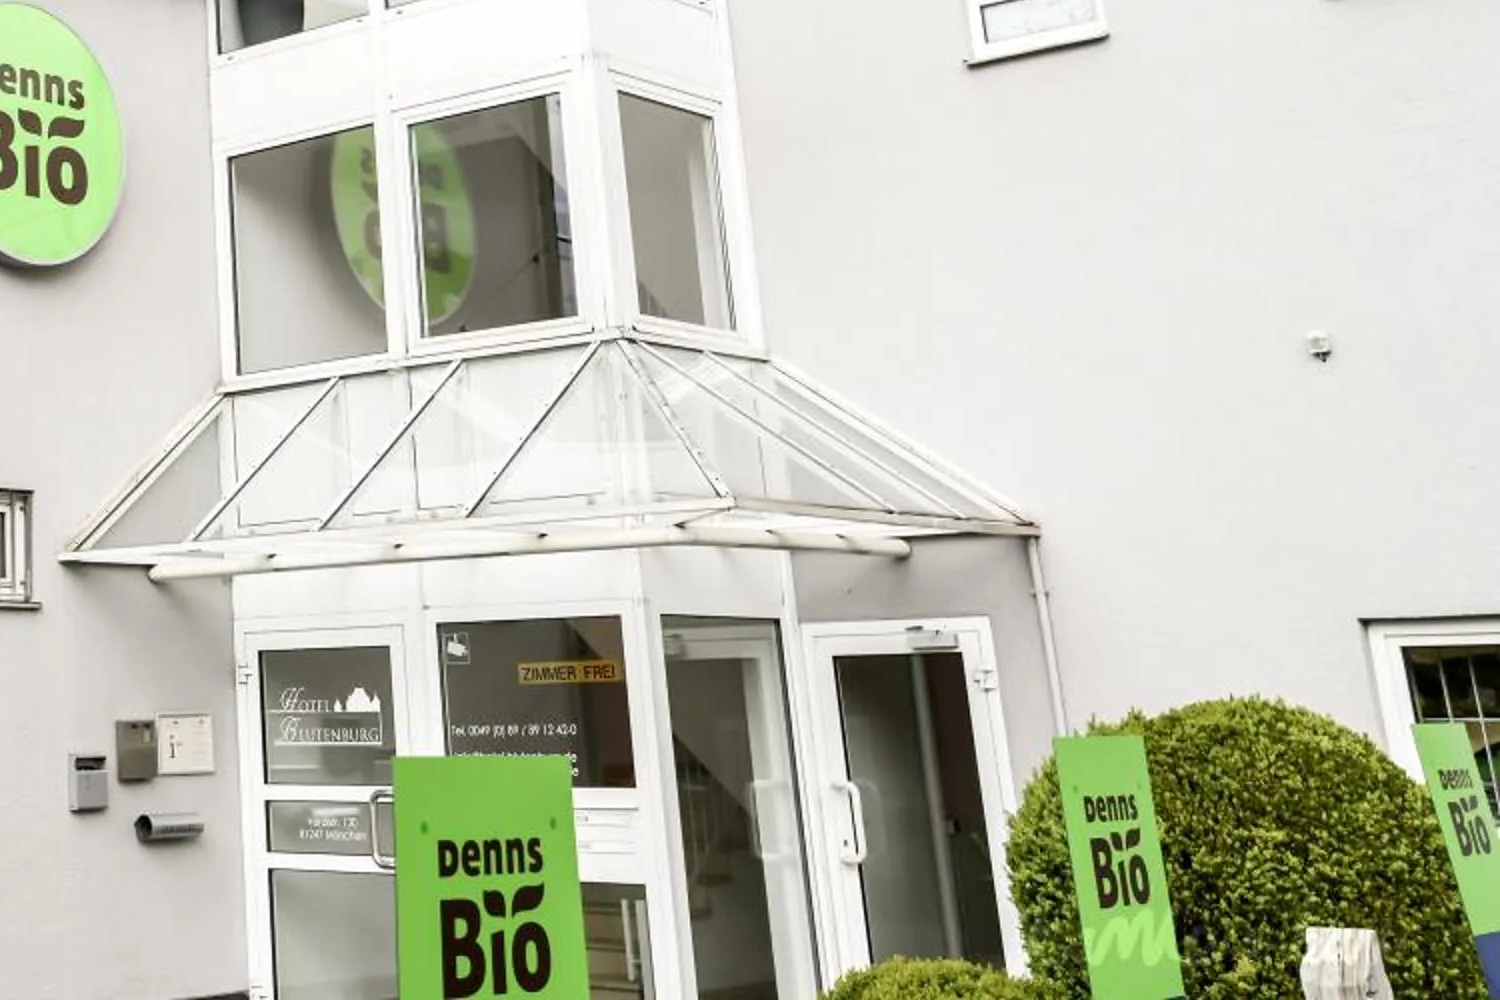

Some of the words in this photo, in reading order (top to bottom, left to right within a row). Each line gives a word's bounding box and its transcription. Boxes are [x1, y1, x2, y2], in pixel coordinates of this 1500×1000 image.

[521, 666, 577, 681] ZIMMER
[583, 663, 616, 679] FREI
[280, 716, 380, 741] BLUTENBURG
[1083, 793, 1139, 822] Denns
[1447, 796, 1491, 857] Bio
[437, 836, 545, 878] Denns
[1090, 828, 1151, 909] Bio
[439, 882, 552, 999] Bio
